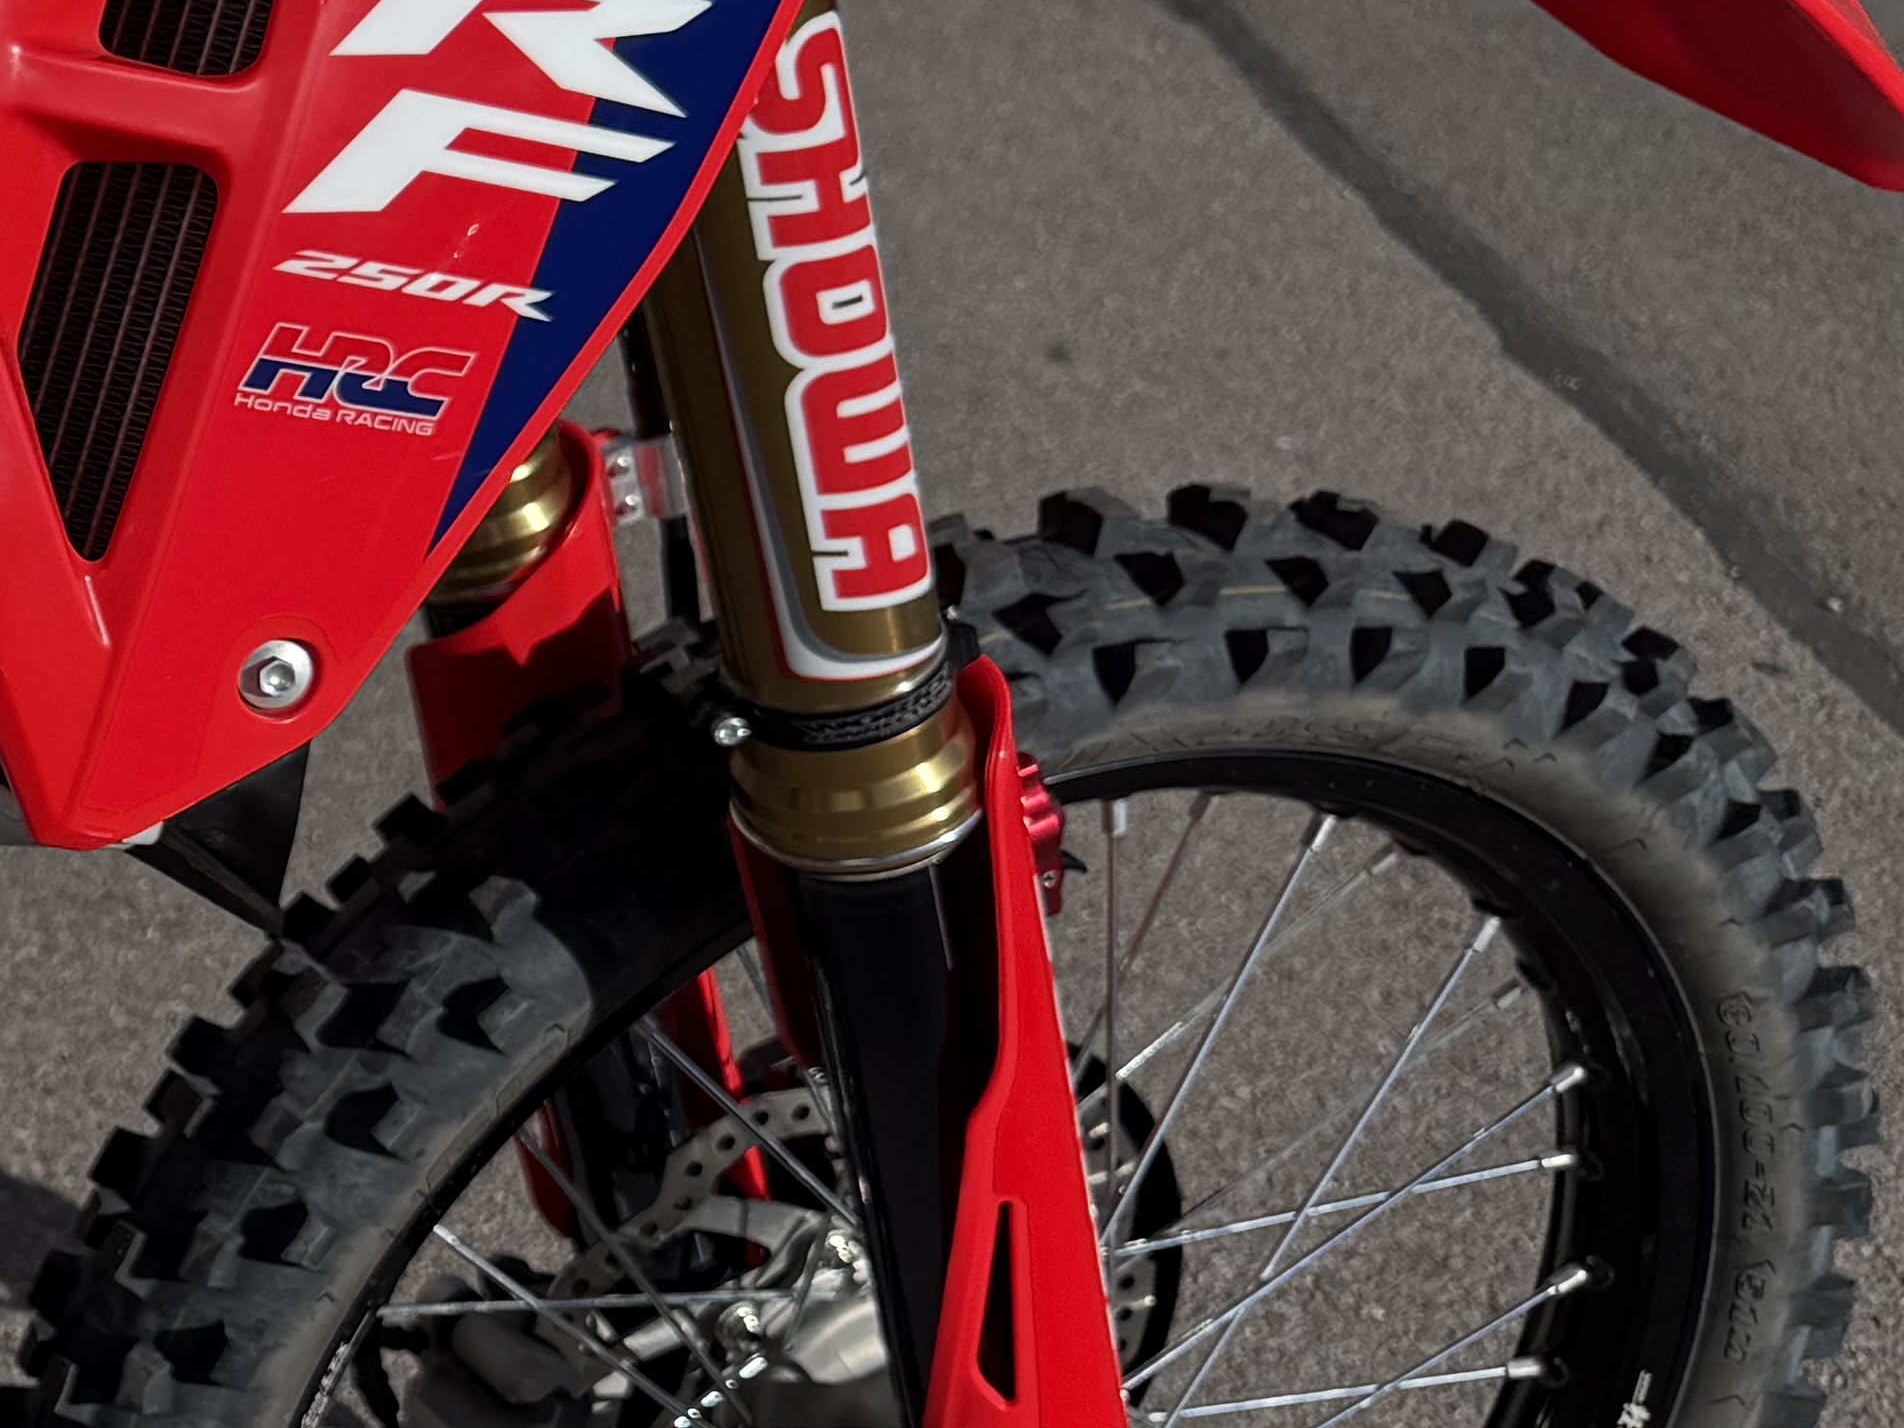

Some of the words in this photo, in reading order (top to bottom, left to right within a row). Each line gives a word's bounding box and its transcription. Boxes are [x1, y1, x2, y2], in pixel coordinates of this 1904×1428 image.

[273, 249, 555, 323] 250R
[734, 9, 930, 614] SHOWA
[233, 391, 331, 423] Honda
[335, 408, 436, 437] RACING
[237, 322, 477, 420] HRC
